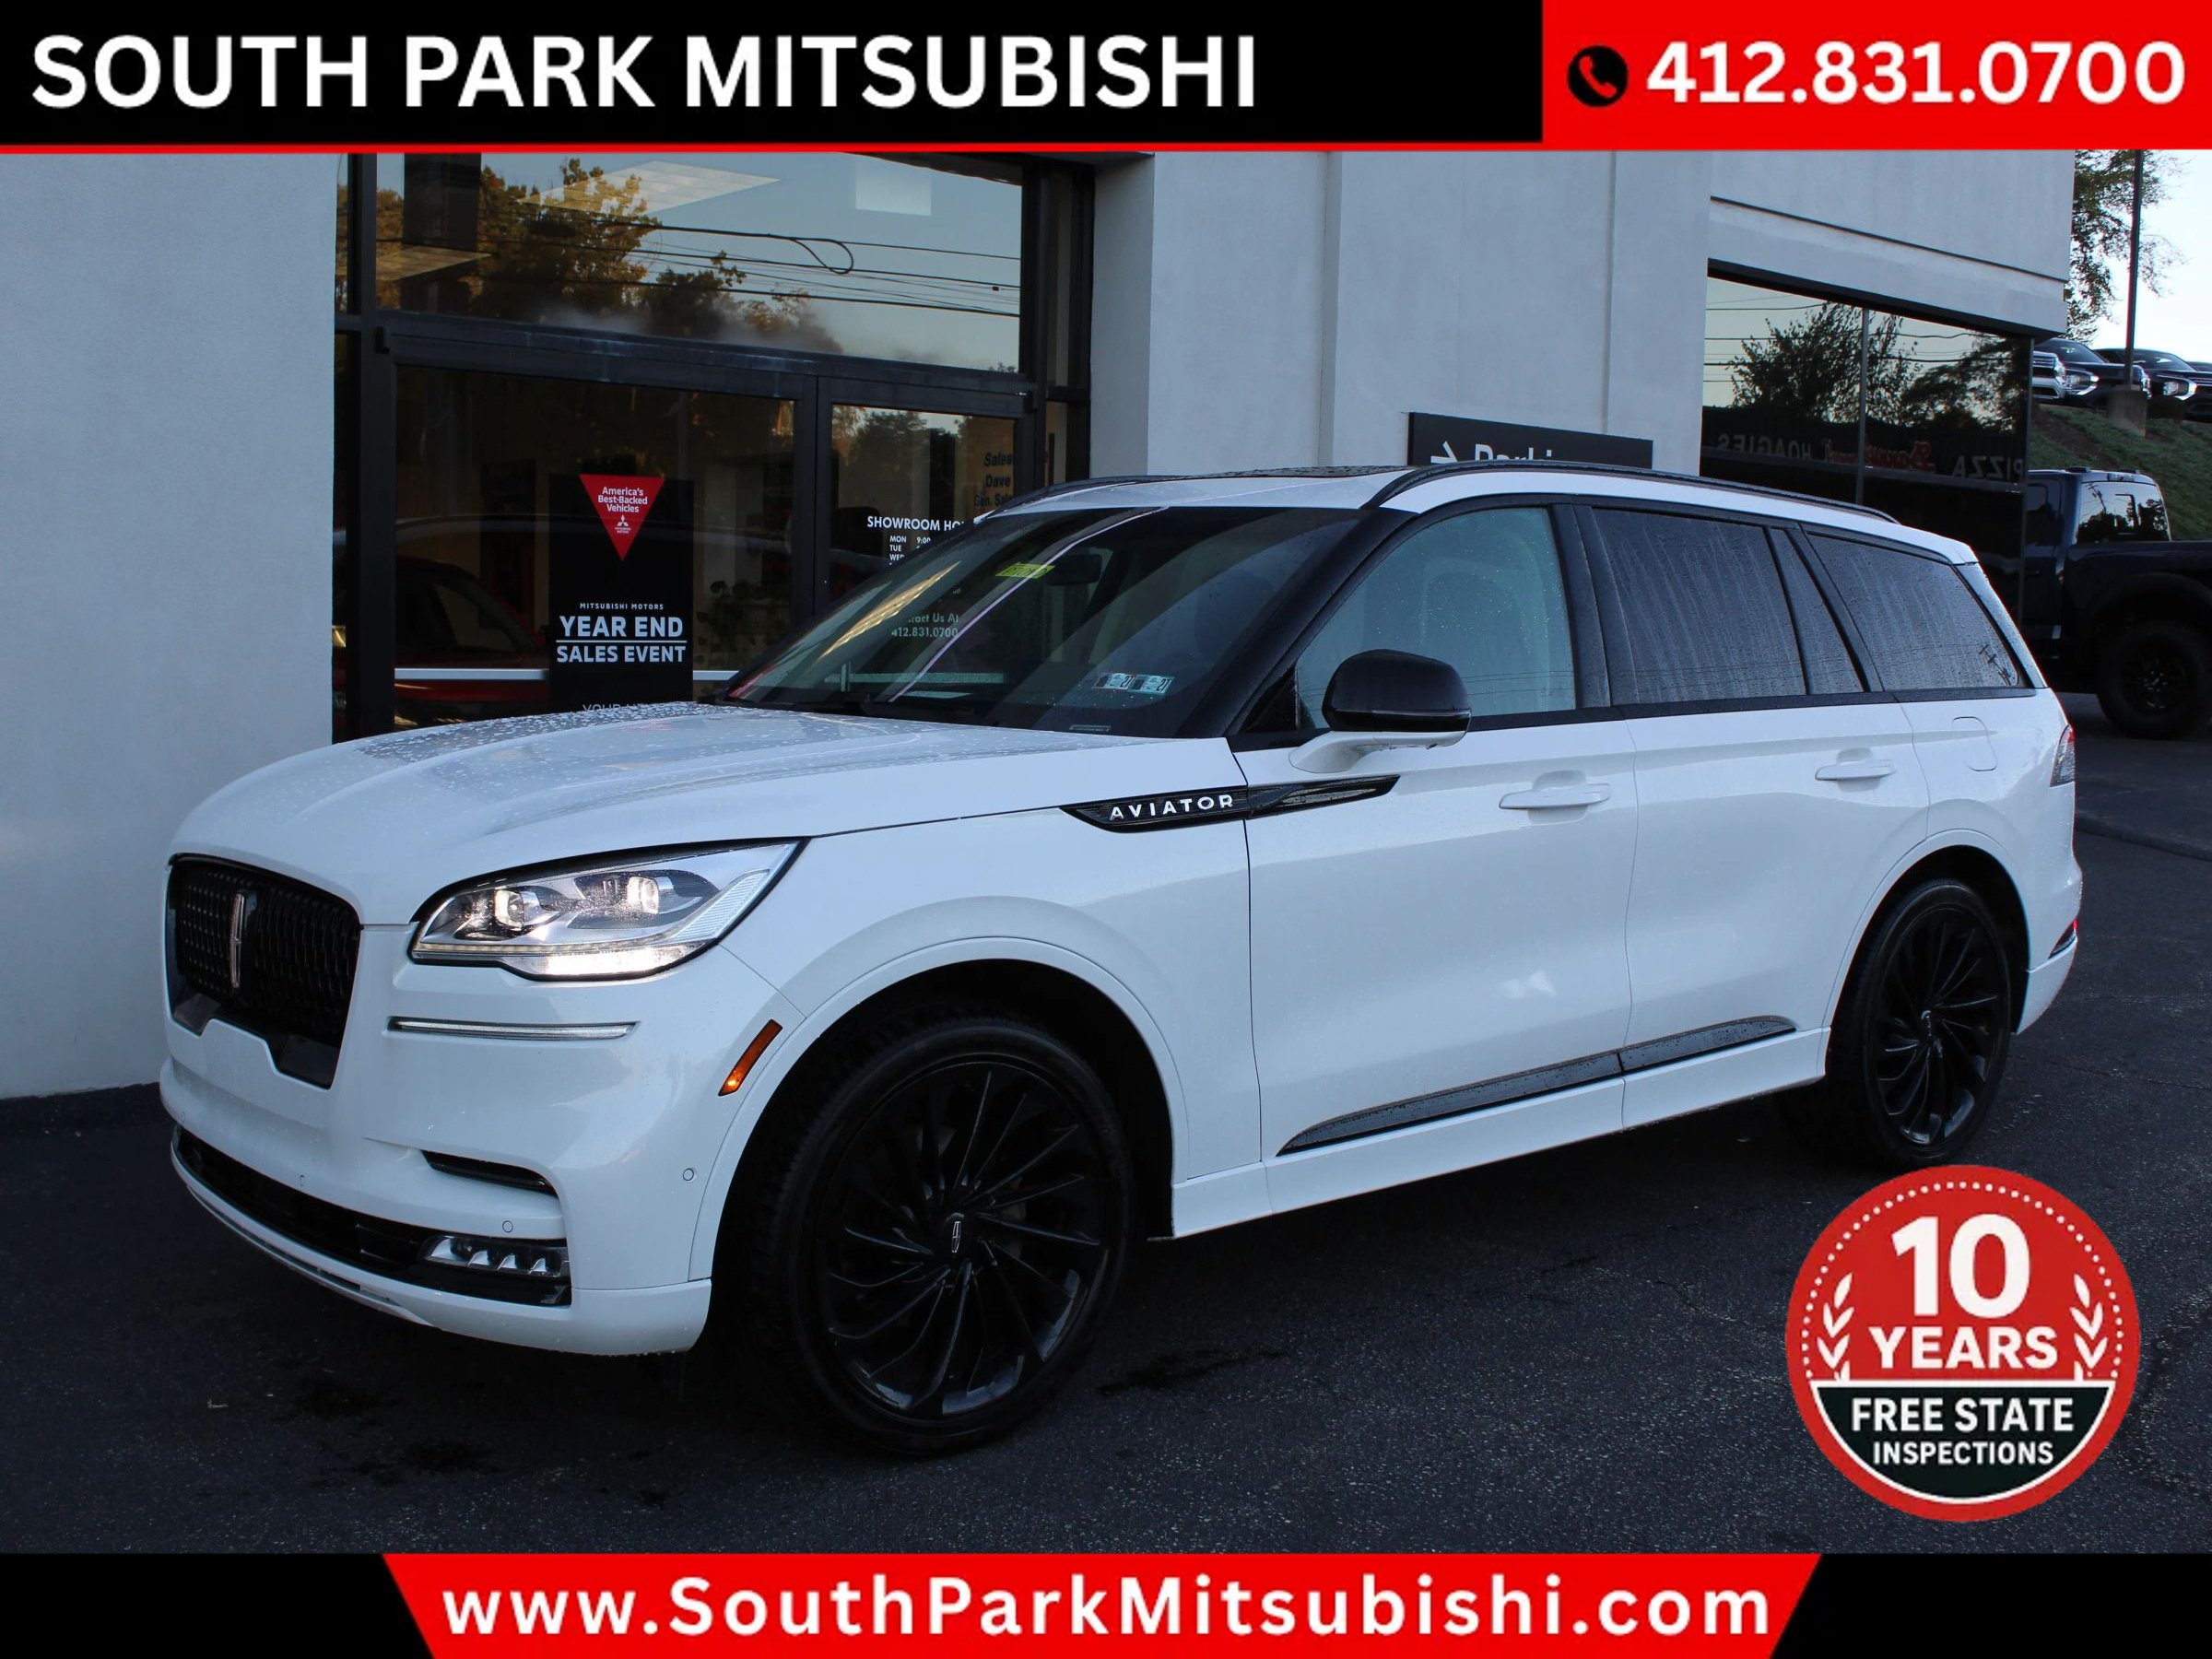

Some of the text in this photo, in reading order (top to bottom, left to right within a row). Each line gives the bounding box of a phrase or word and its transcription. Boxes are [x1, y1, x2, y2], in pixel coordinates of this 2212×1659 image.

[985, 476, 1011, 488] Dave
[602, 487, 643, 496] America's
[597, 495, 648, 505] Best-Backed
[606, 504, 640, 513] Vehicles
[867, 515, 940, 531] SHOWROOM
[932, 612, 945, 623] Us
[559, 616, 683, 638] YEAR END
[891, 626, 959, 637] 412.831.0700
[557, 645, 687, 663] SALES EVENT
[1109, 794, 1233, 821] AVIATOR
